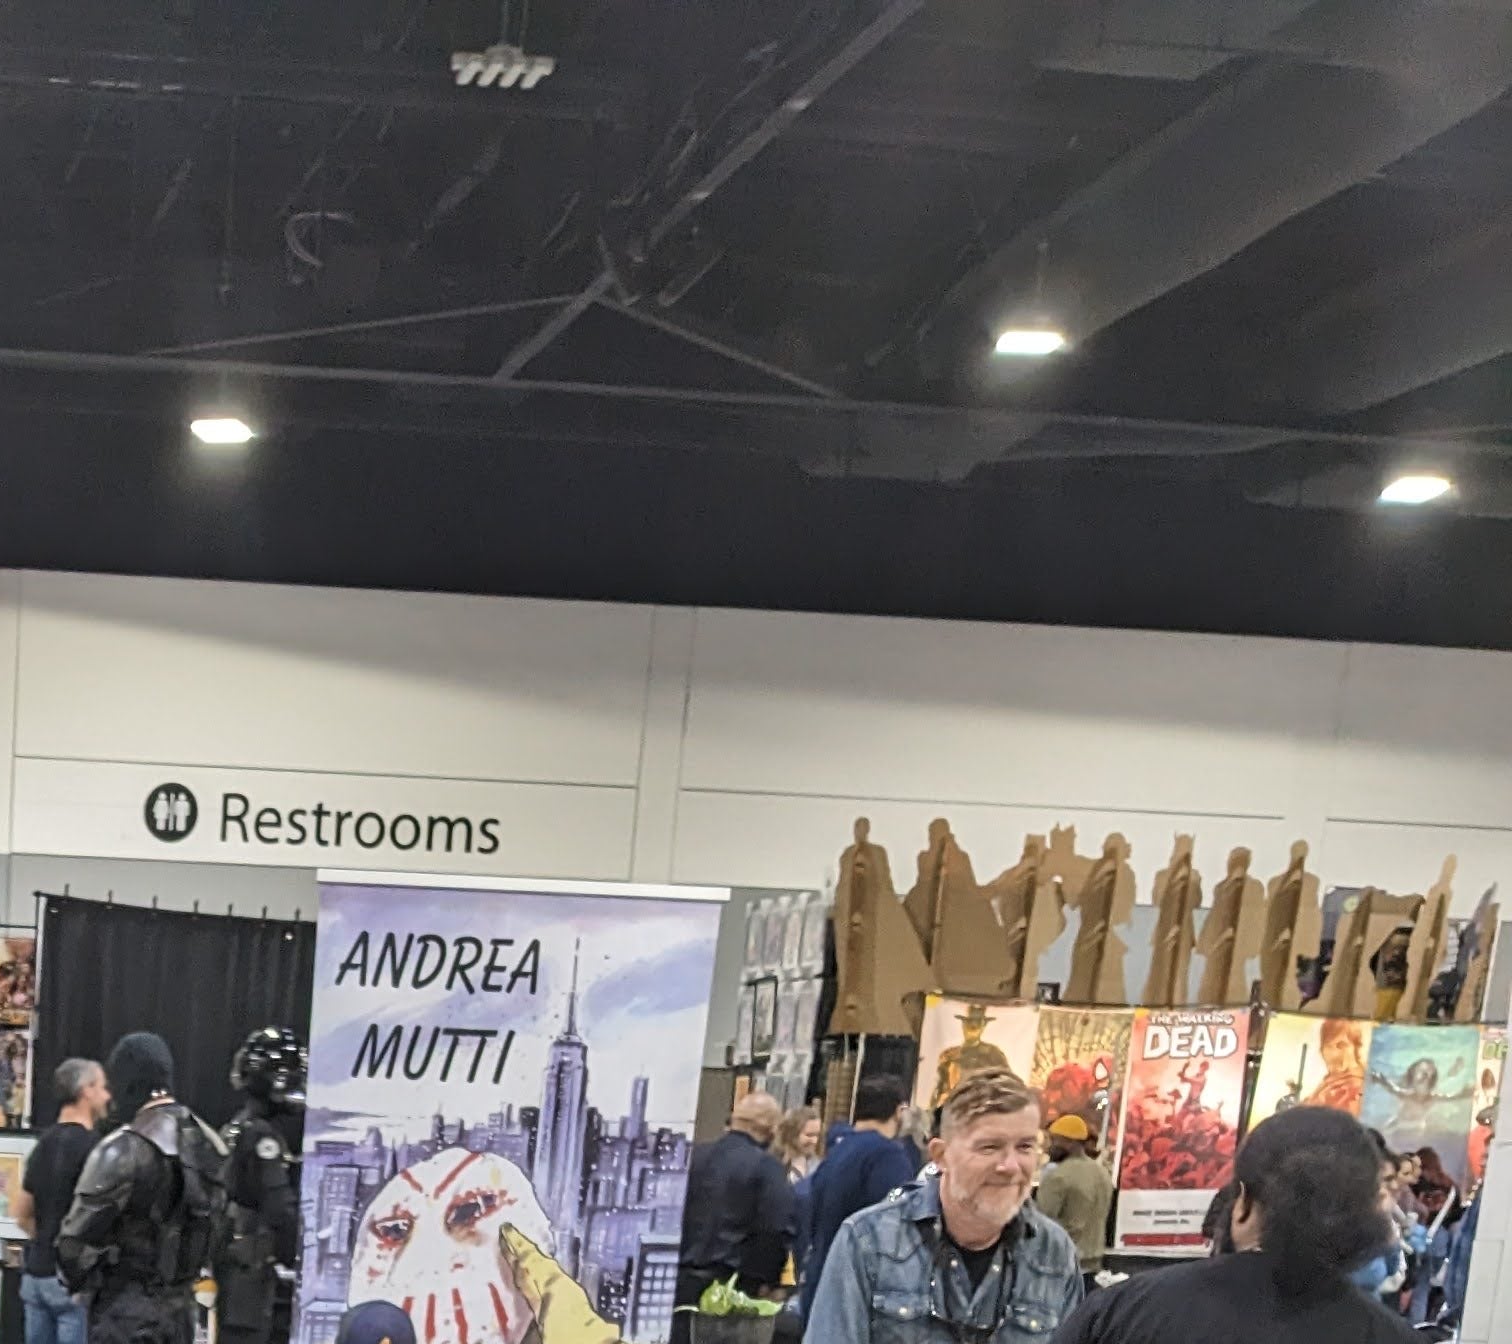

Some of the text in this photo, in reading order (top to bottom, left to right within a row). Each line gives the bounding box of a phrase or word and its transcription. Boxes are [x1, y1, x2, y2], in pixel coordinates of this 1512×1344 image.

[219, 791, 500, 855] Restrooms
[335, 930, 541, 995] ANDREA
[350, 1023, 516, 1085] MUTTI
[1142, 1025, 1238, 1060] DEAD
